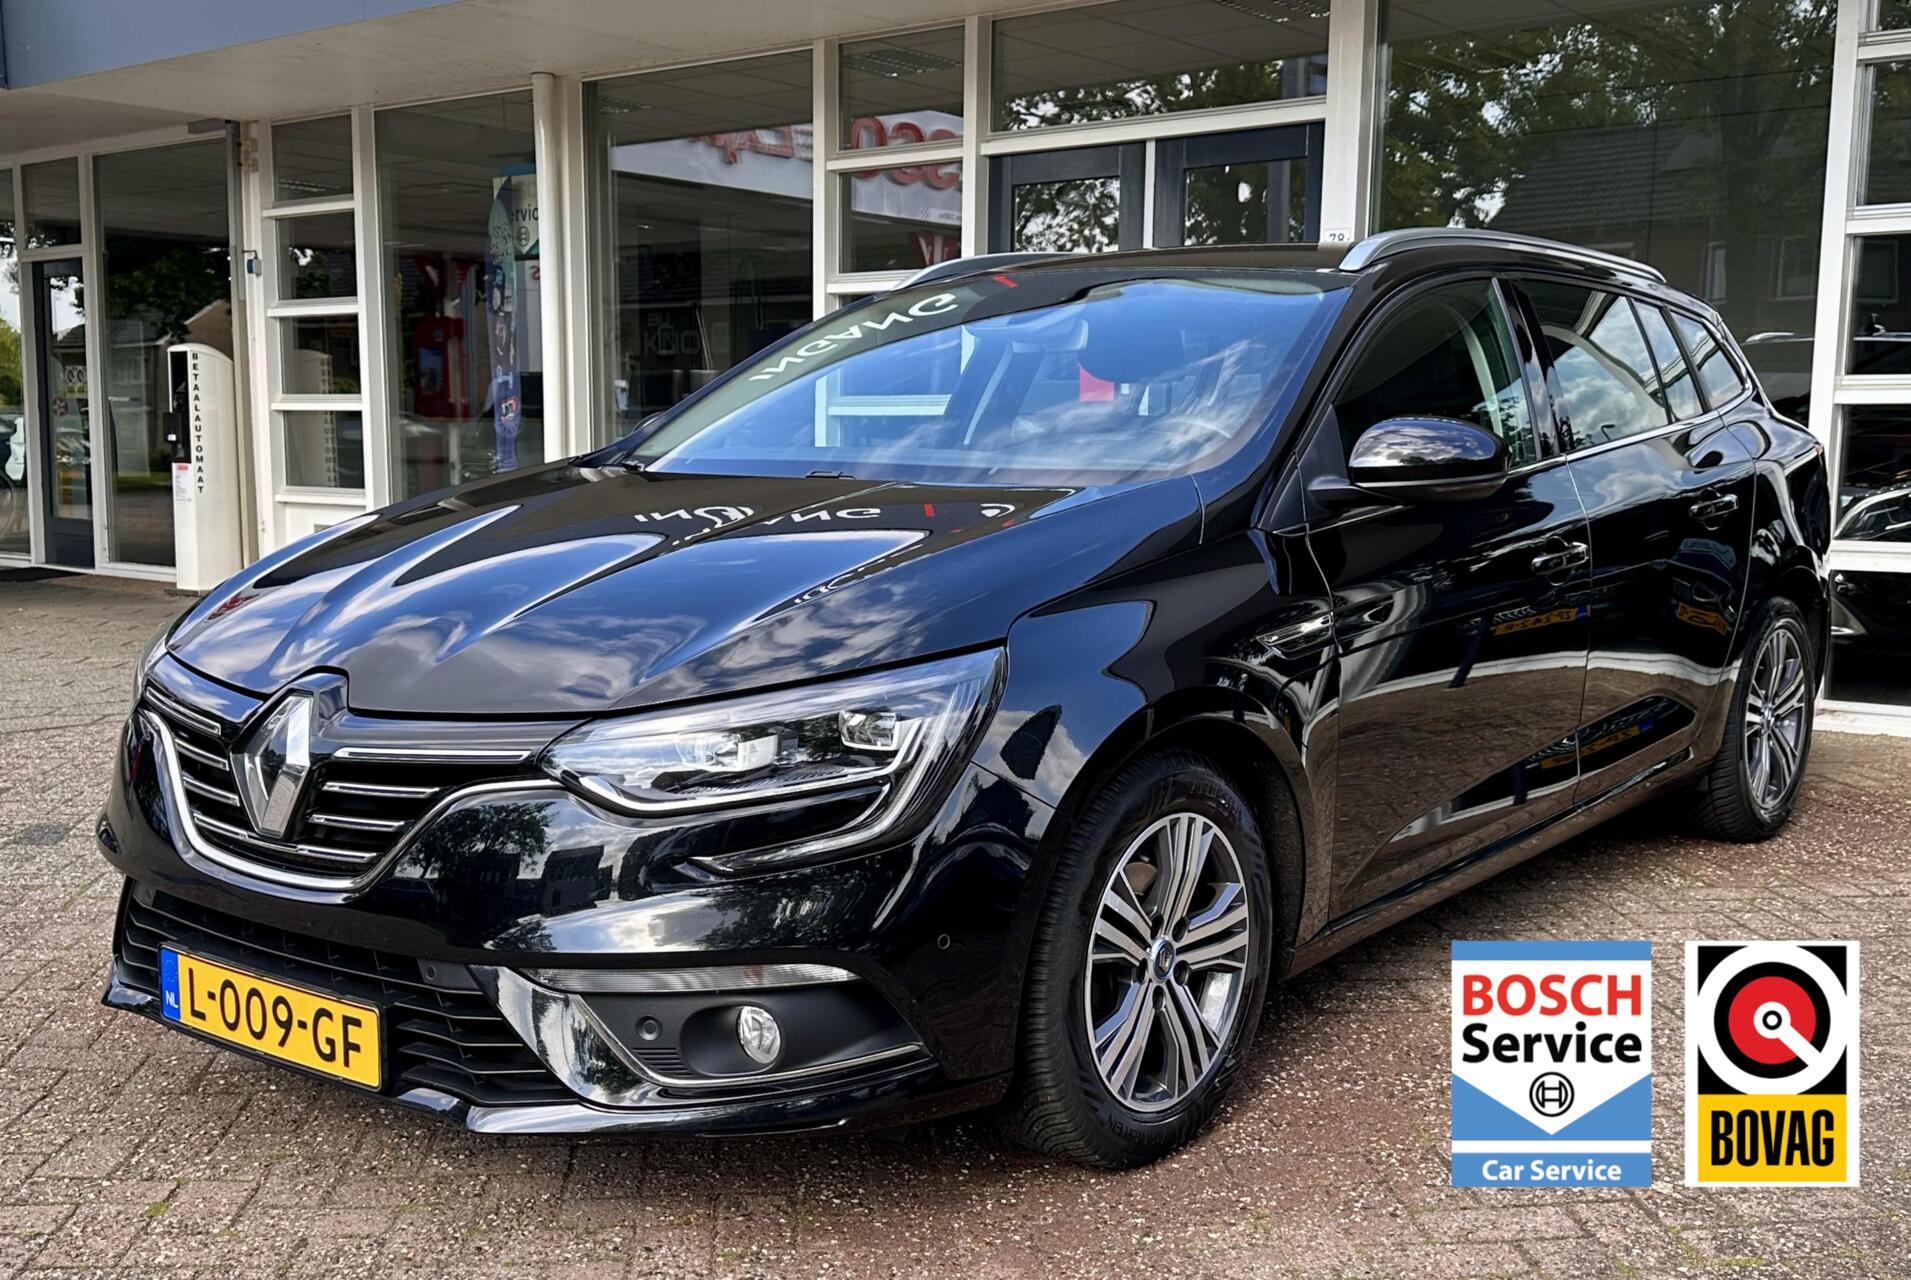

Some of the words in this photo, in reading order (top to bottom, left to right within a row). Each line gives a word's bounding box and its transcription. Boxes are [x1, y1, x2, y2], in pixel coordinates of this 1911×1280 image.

[191, 352, 204, 493] BETAALAUTOMAAT
[165, 990, 179, 1009] NL
[188, 967, 363, 1069] L-009-GF
